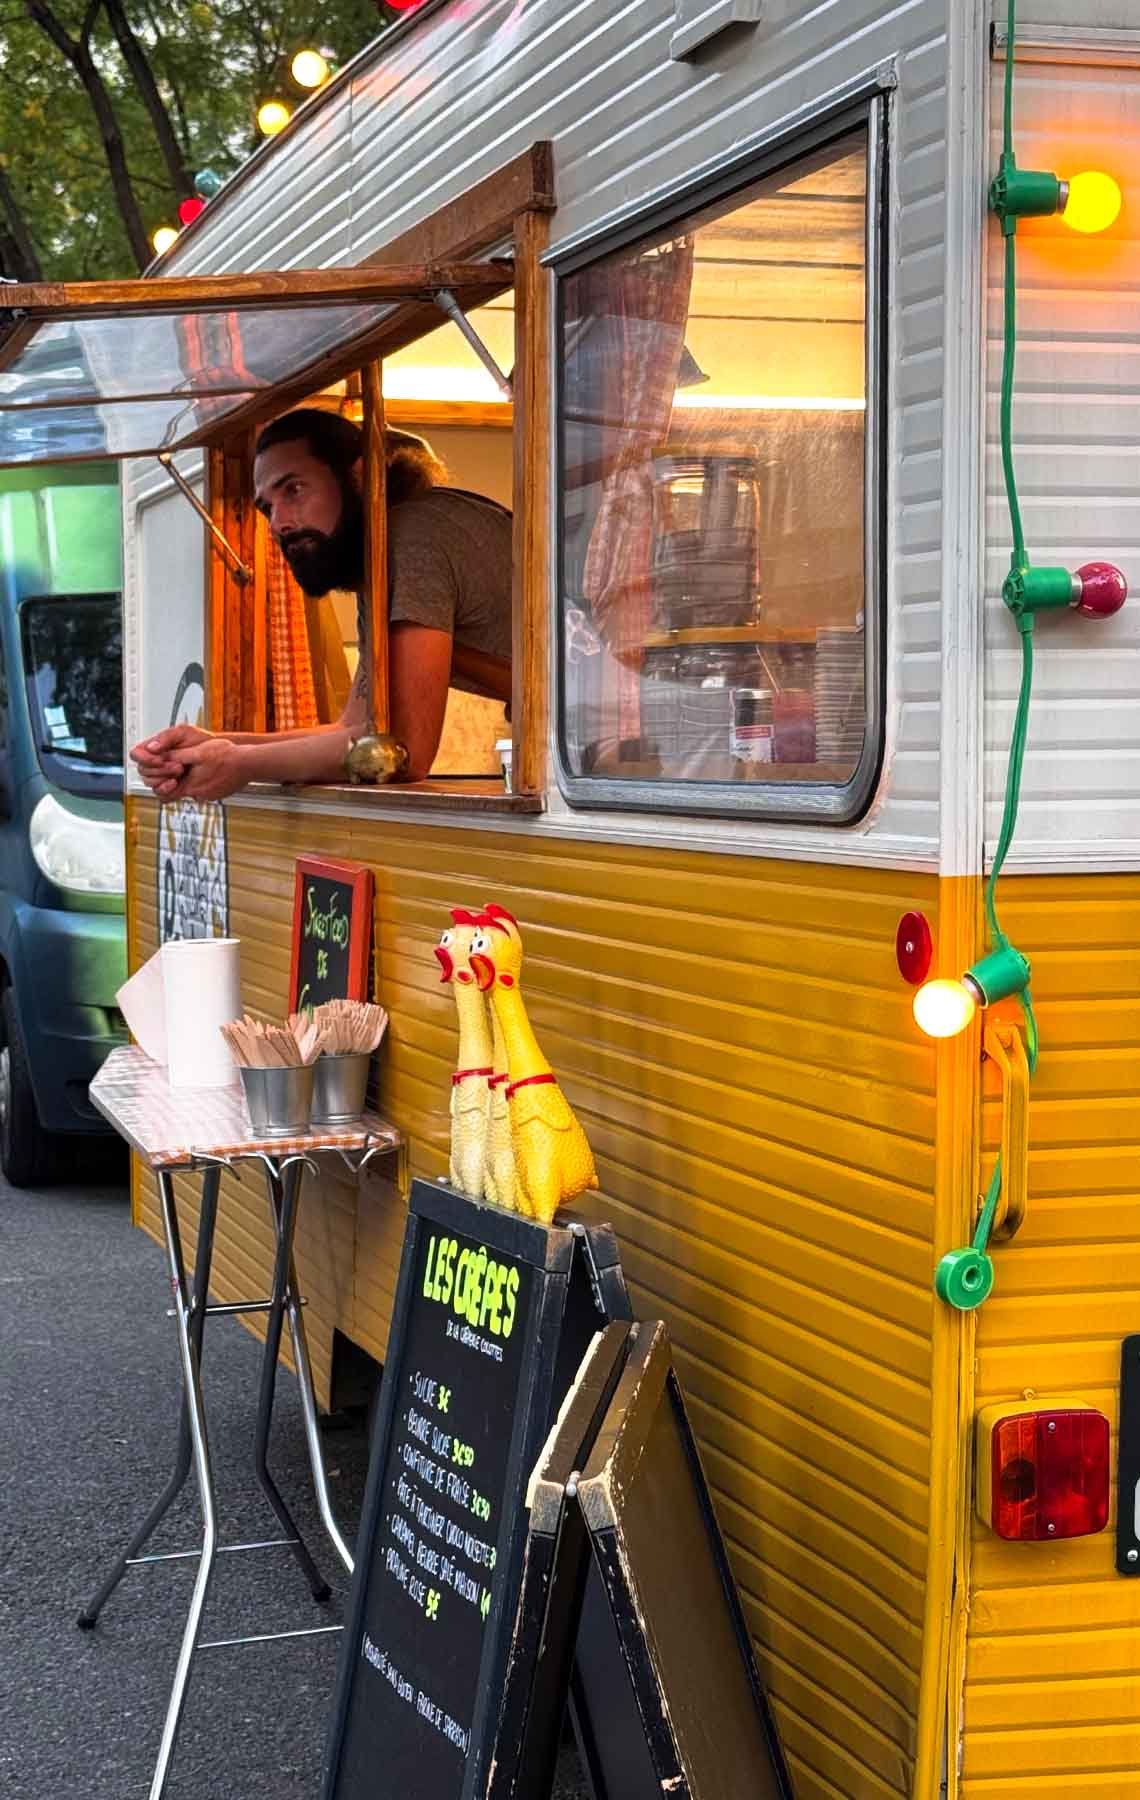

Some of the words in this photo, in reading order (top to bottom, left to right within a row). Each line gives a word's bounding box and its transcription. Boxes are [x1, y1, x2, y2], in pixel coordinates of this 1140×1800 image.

[423, 1236, 458, 1304] LES
[453, 1246, 520, 1338] CRÊPES
[445, 1320, 453, 1337] DE
[413, 1371, 437, 1407] SUCRE
[437, 1385, 452, 1413] 3€
[407, 1407, 431, 1445] BEURRE
[431, 1426, 452, 1459] SUCRE
[403, 1443, 437, 1484] CONFITURE
[434, 1466, 446, 1493] DE
[391, 1514, 415, 1557] CARAMEL
[408, 1575, 427, 1607] ROSE
[425, 1588, 441, 1621] 5€
